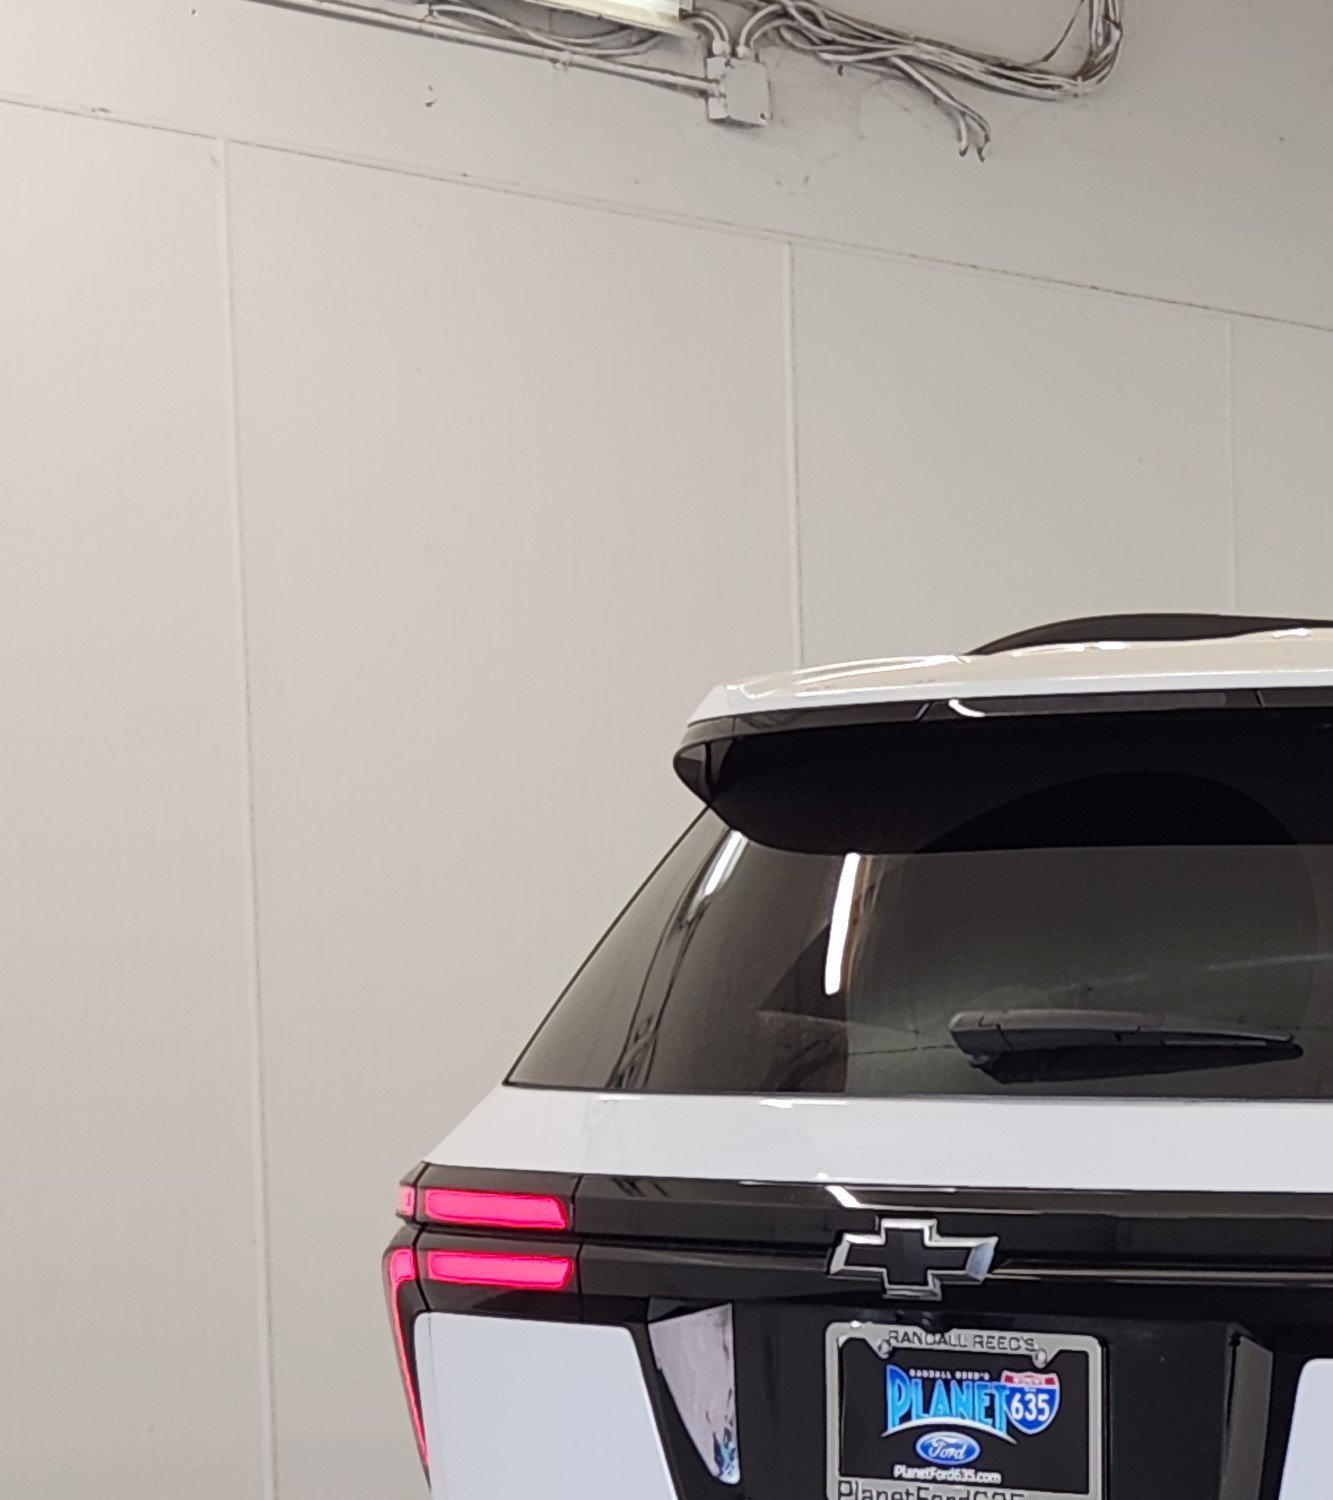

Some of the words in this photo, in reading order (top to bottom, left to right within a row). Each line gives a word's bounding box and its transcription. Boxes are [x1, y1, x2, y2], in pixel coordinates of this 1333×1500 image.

[888, 1329, 968, 1347] RANDALL
[886, 1364, 1010, 1434] PLANET
[1010, 1393, 1050, 1422] 635
[928, 1437, 968, 1460] Ford
